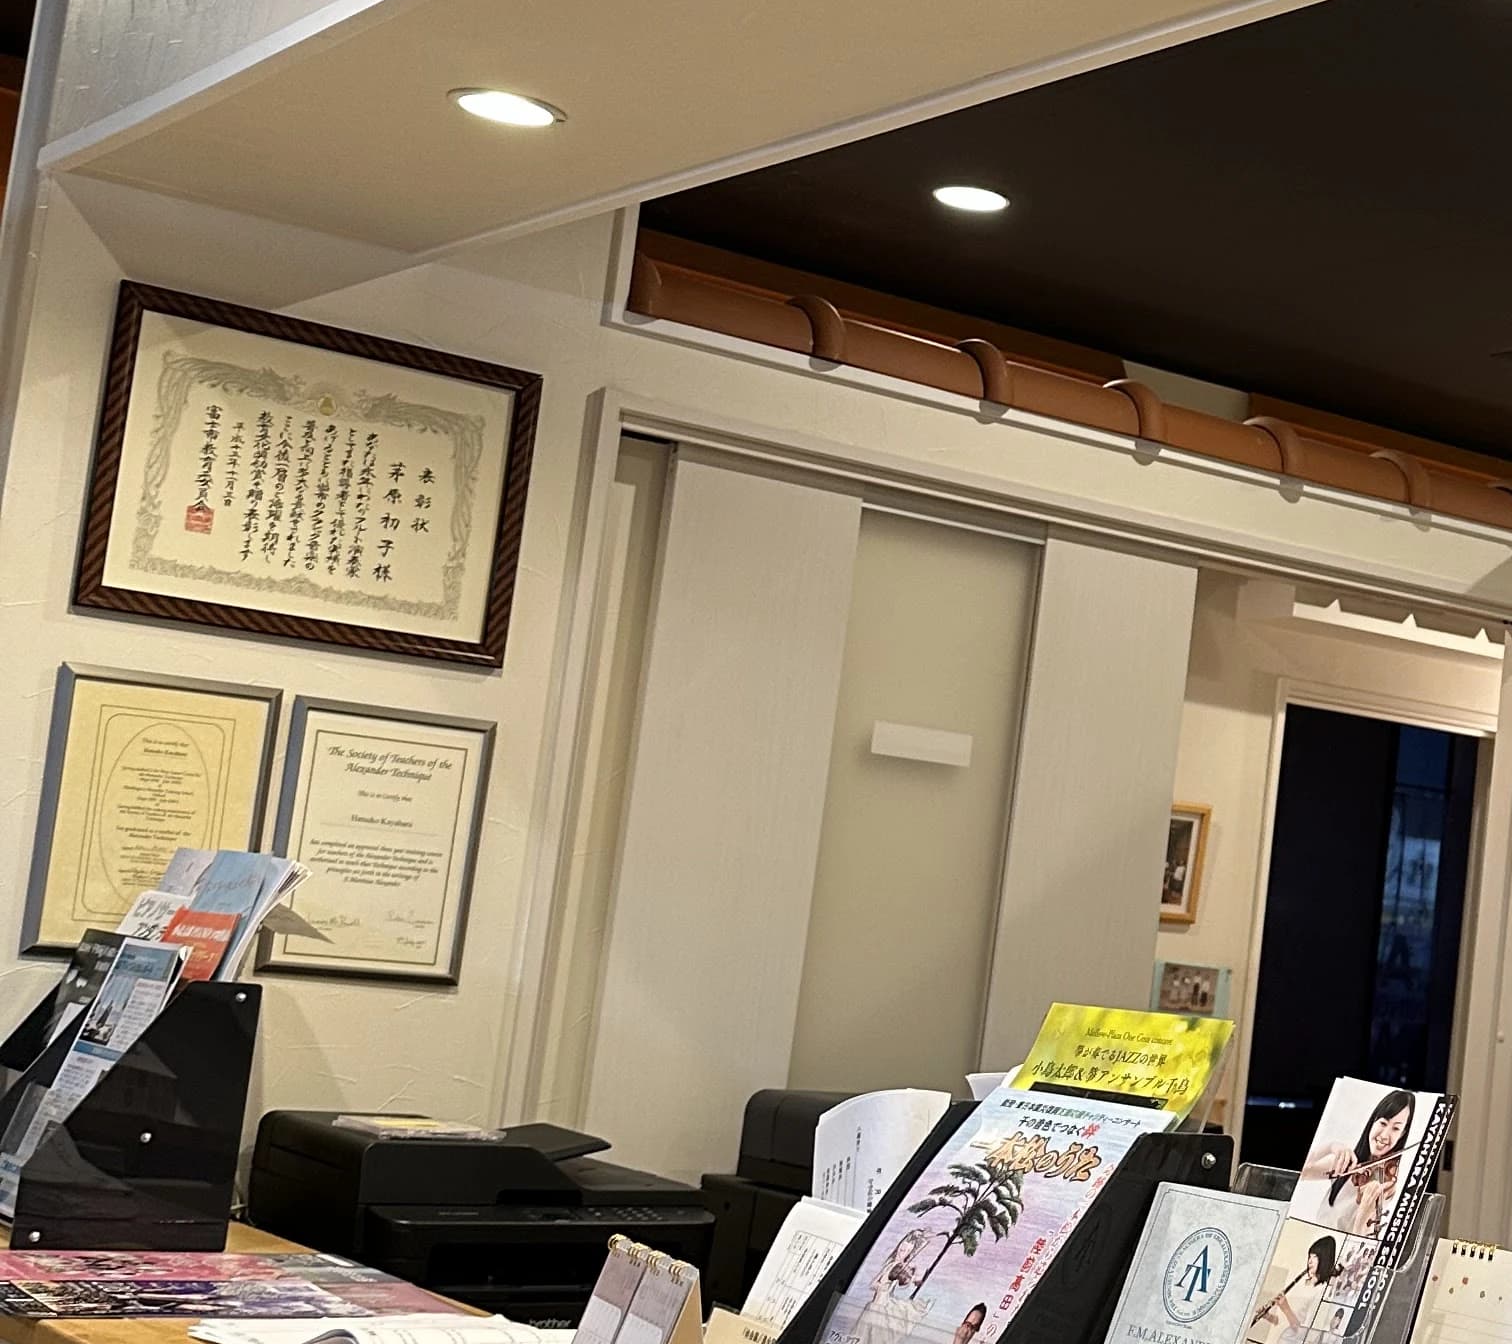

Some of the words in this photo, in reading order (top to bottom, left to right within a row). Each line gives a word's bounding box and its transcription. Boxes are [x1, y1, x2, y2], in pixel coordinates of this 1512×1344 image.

[411, 468, 435, 533] 表彰状
[328, 745, 346, 757] The
[346, 748, 378, 764] Society
[379, 751, 391, 765] of
[390, 753, 426, 767] Teachers
[428, 757, 439, 770] of
[439, 758, 453, 770] the
[345, 762, 389, 778] Alexander
[390, 767, 433, 784] Technique
[1408, 1102, 1446, 1188] KAYAHARA
[1386, 1192, 1412, 1242] MUSIC
[1358, 1245, 1391, 1310] SCHOOL
